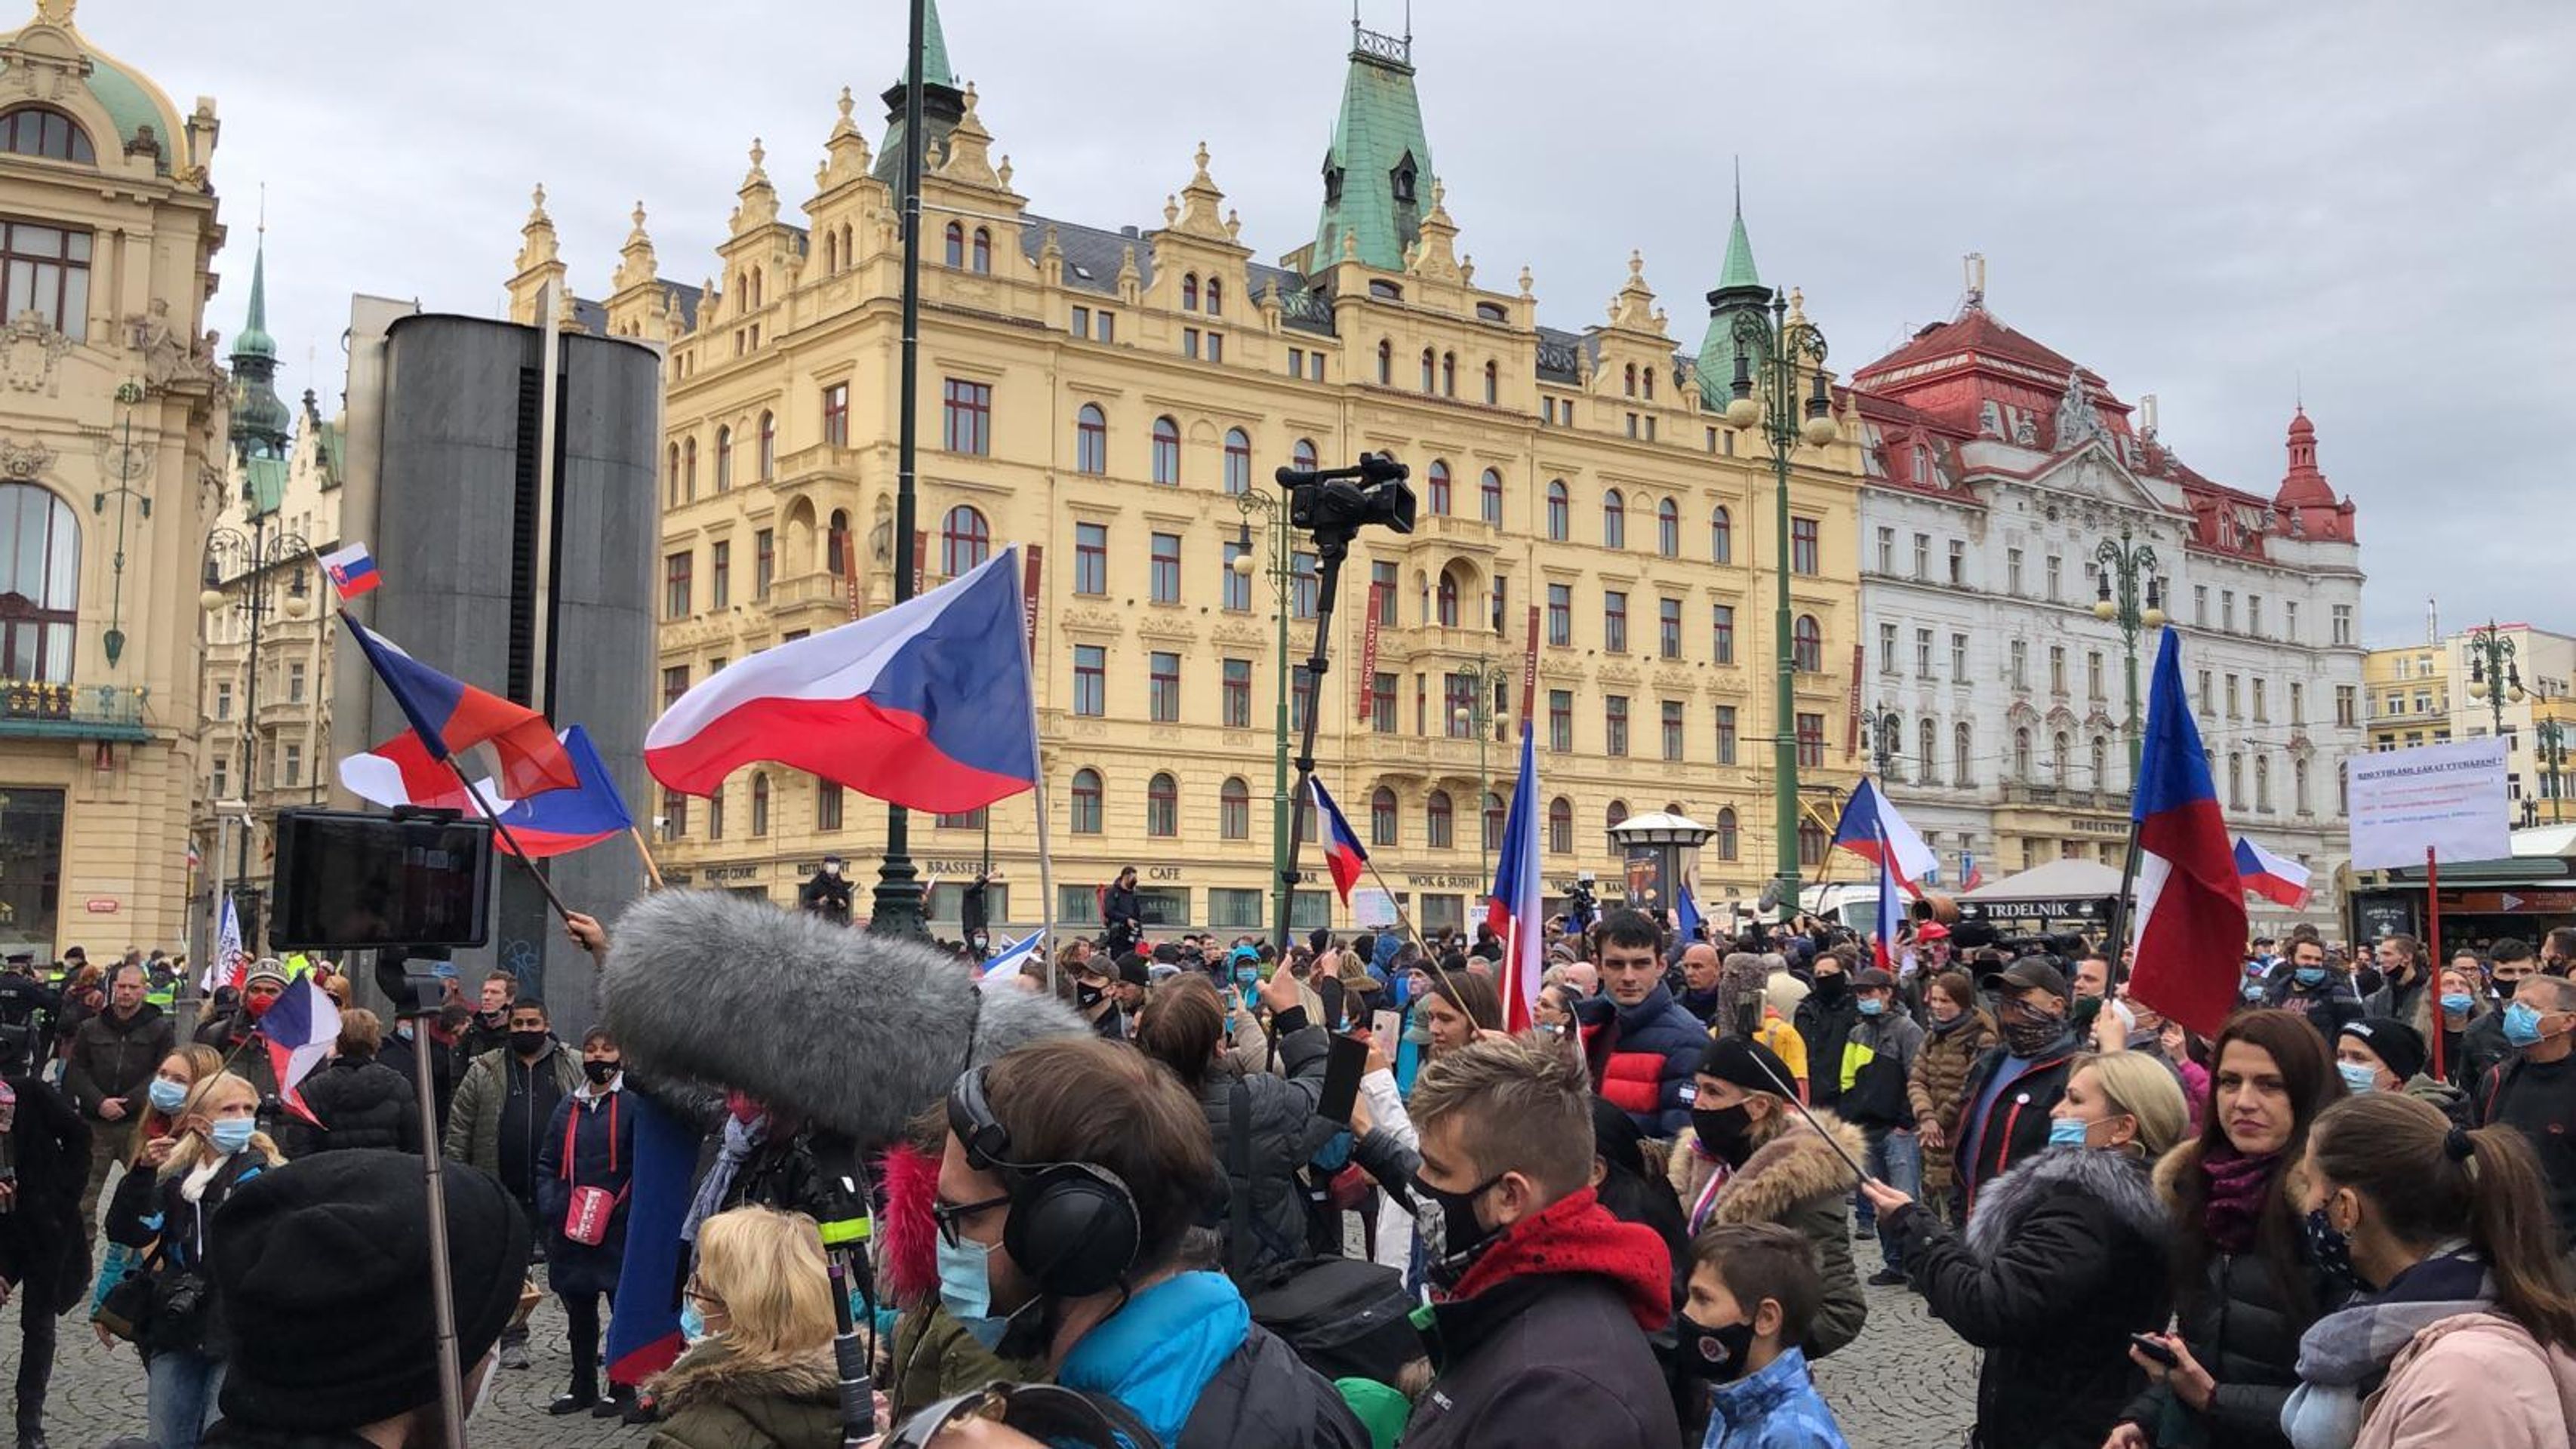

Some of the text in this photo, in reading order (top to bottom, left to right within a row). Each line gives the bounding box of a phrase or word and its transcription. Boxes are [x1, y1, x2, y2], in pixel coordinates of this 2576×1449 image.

[927, 861, 997, 874] BRASSERE
[1408, 875, 1479, 889] WOK & SUSHI
